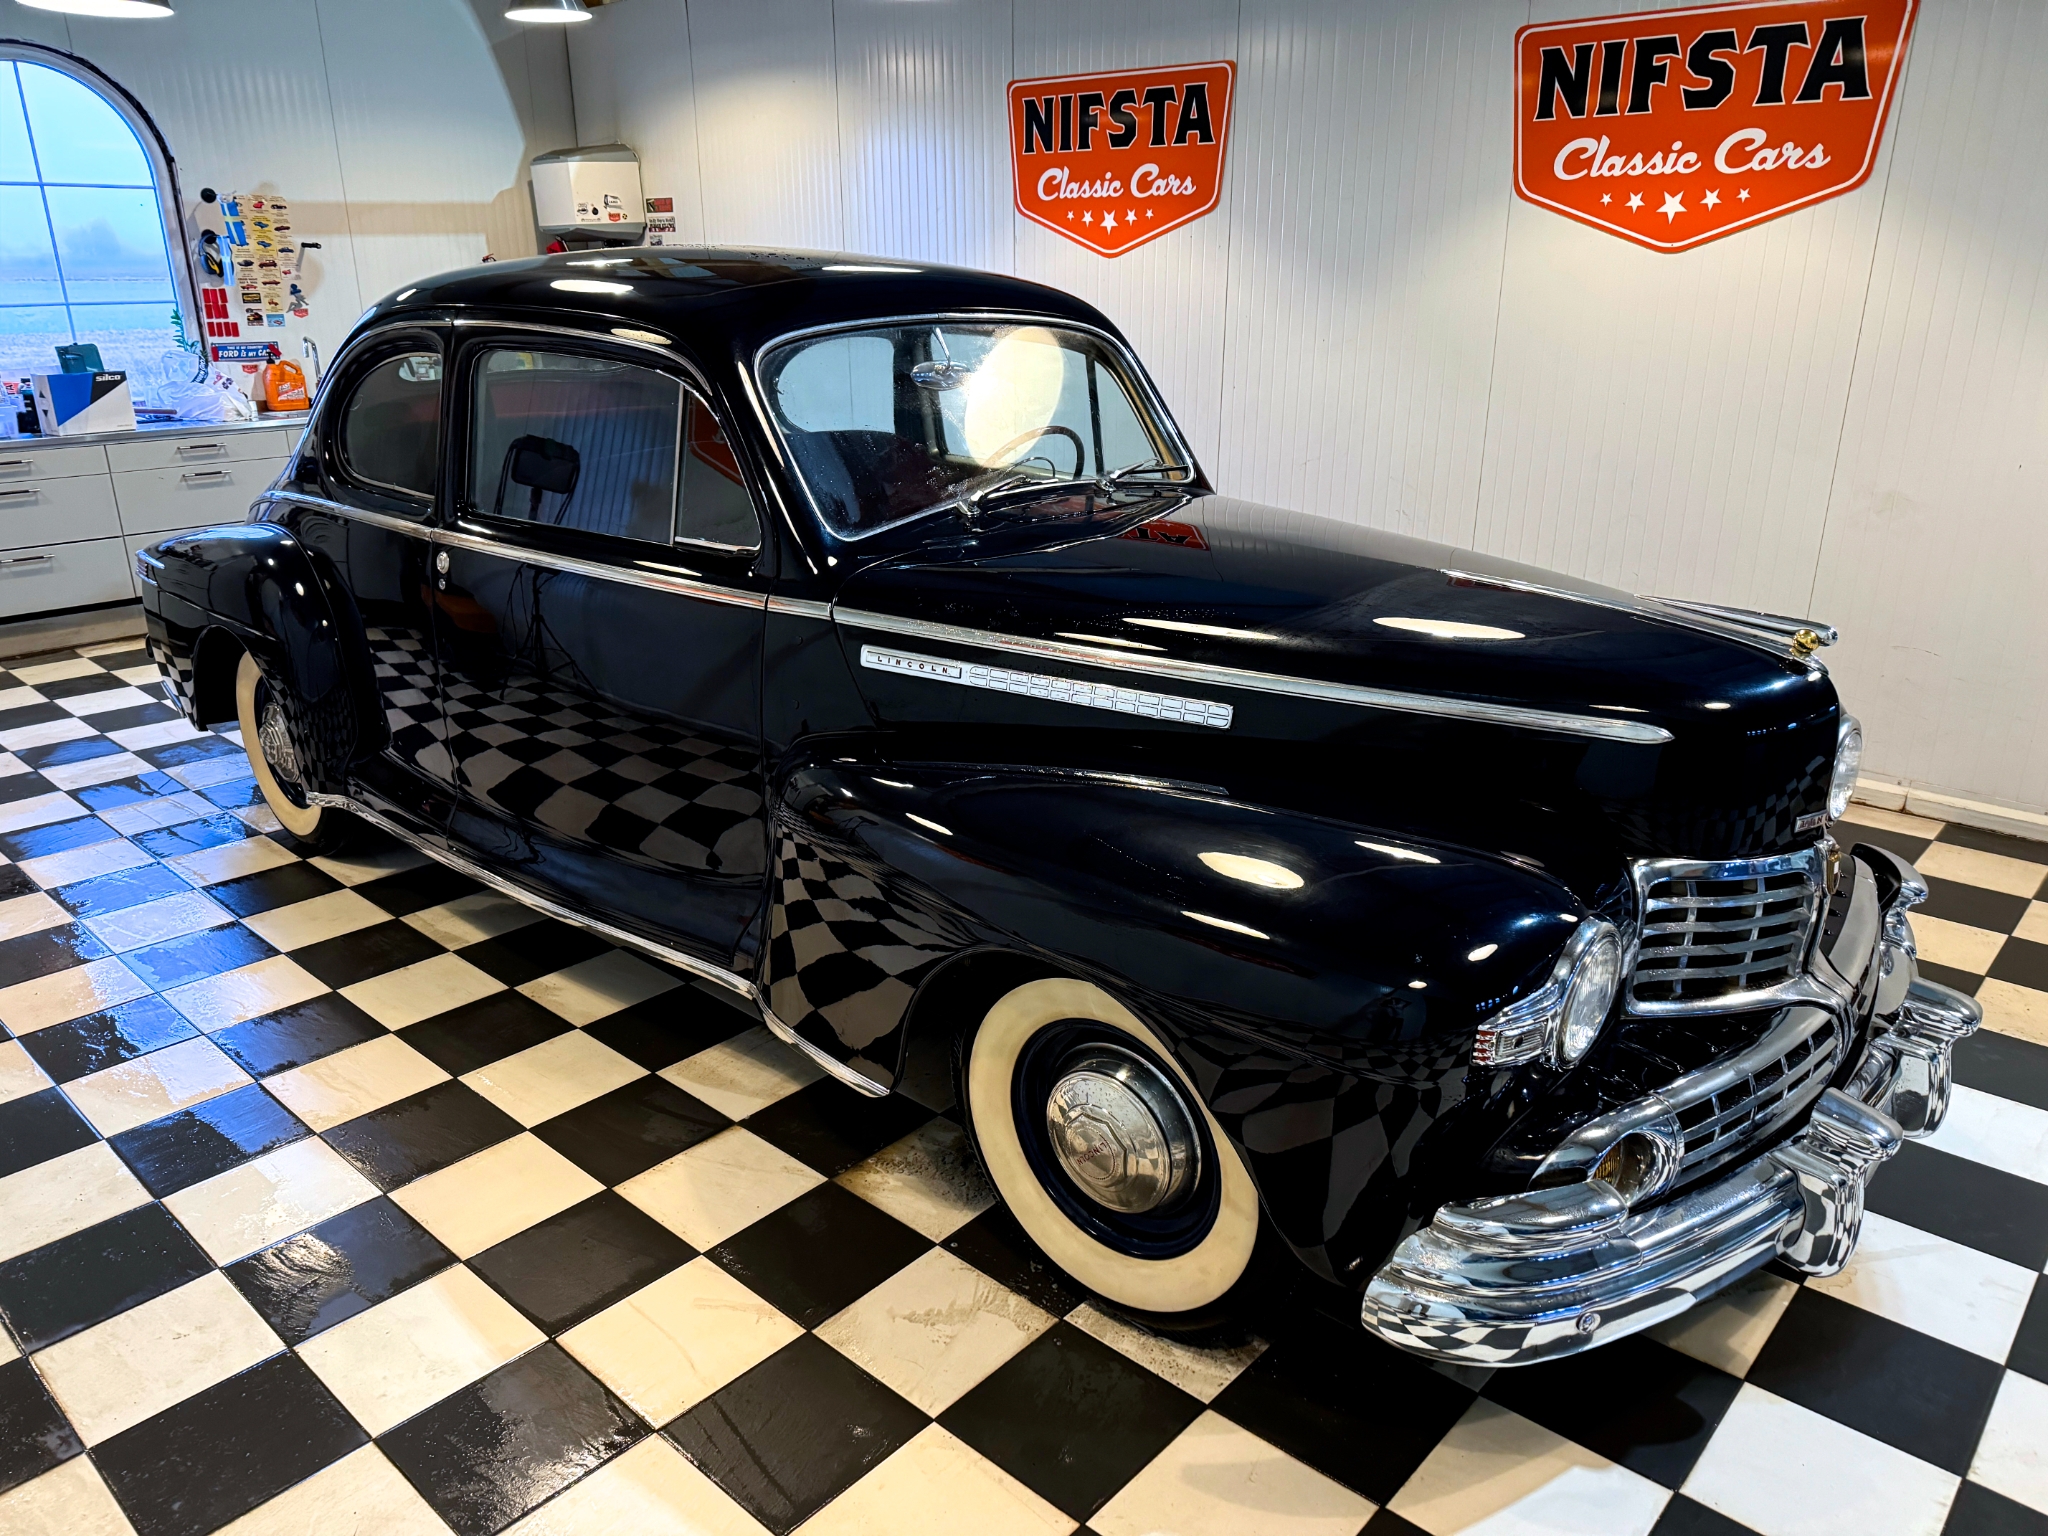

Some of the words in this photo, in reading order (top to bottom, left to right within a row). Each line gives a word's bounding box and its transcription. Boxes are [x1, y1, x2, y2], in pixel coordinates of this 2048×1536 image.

[1533, 15, 1873, 121] NIFSTA
[1022, 82, 1216, 155] NIFSTA
[1553, 135, 1701, 180] Classic
[1714, 128, 1831, 174] Cars
[1037, 165, 1124, 201] Classic
[1130, 163, 1197, 198] Cars
[218, 350, 239, 358] FORD
[95, 373, 121, 382] silco
[877, 655, 948, 674] LINCOLN
[1076, 1141, 1108, 1166] LINCOLN
